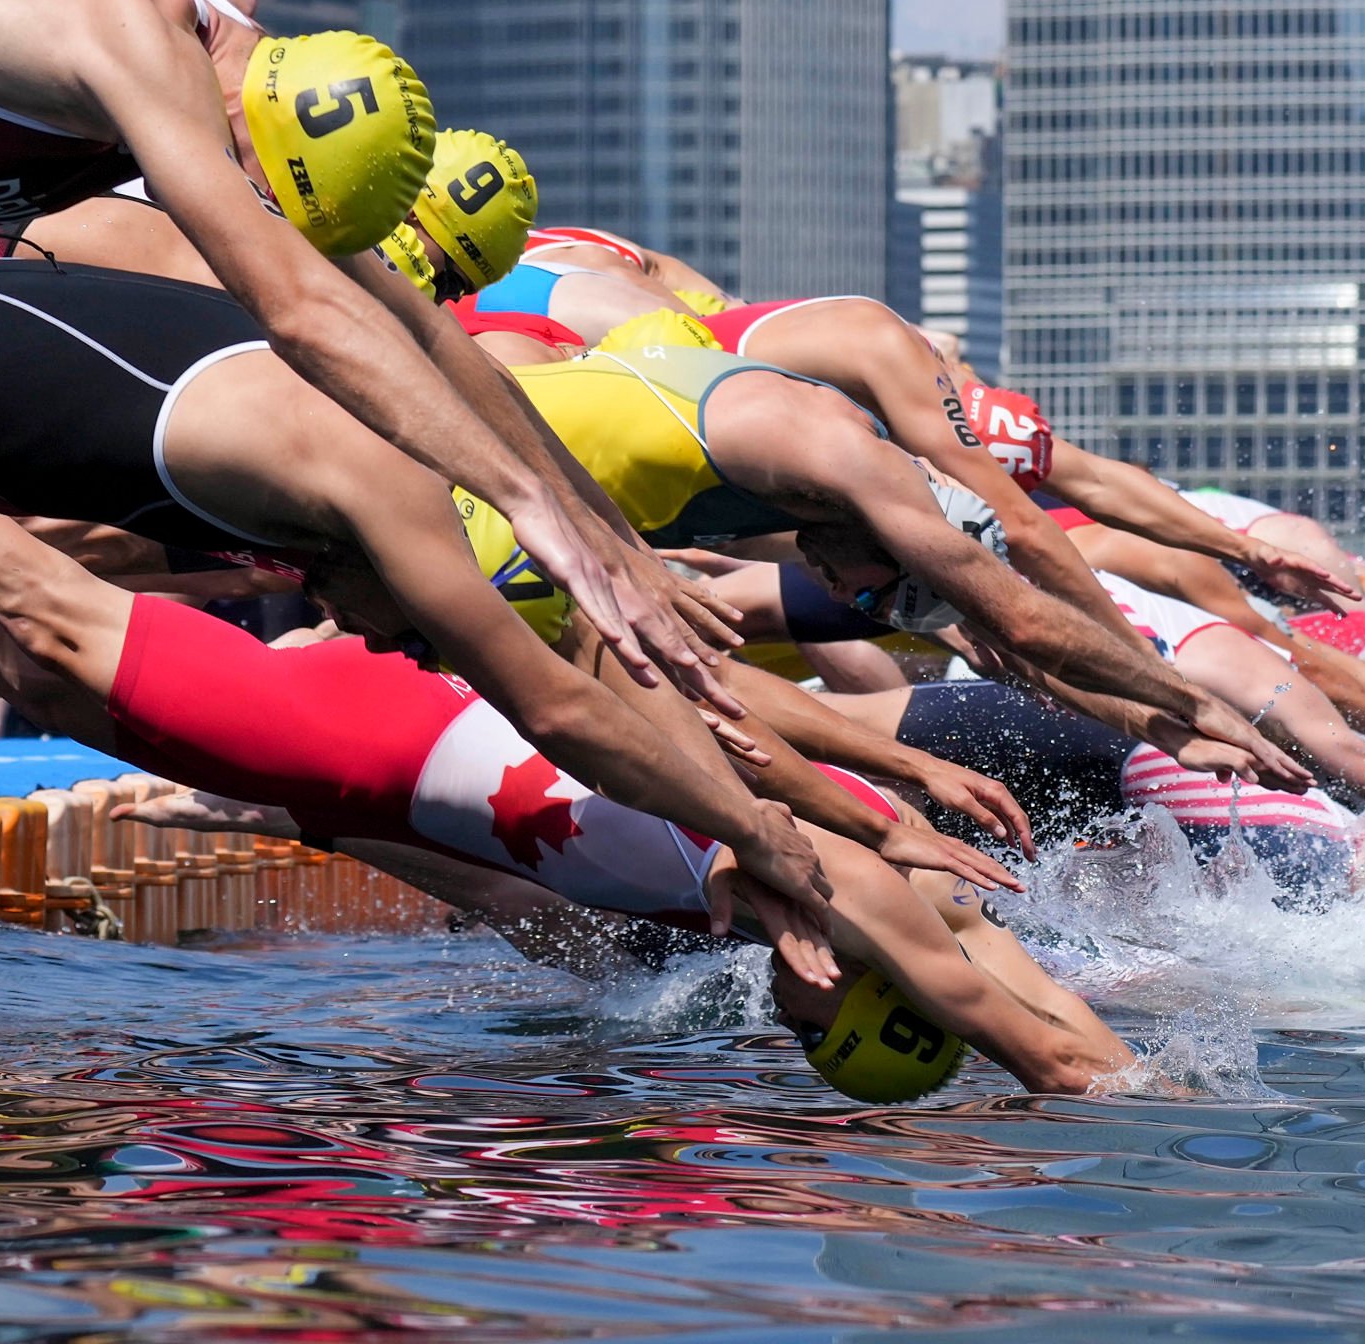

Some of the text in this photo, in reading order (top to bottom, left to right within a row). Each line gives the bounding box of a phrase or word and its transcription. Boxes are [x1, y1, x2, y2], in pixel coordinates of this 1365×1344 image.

[295, 76, 380, 140] 5
[447, 161, 505, 215] 9
[942, 397, 982, 448] 26
[987, 405, 1039, 475] 26
